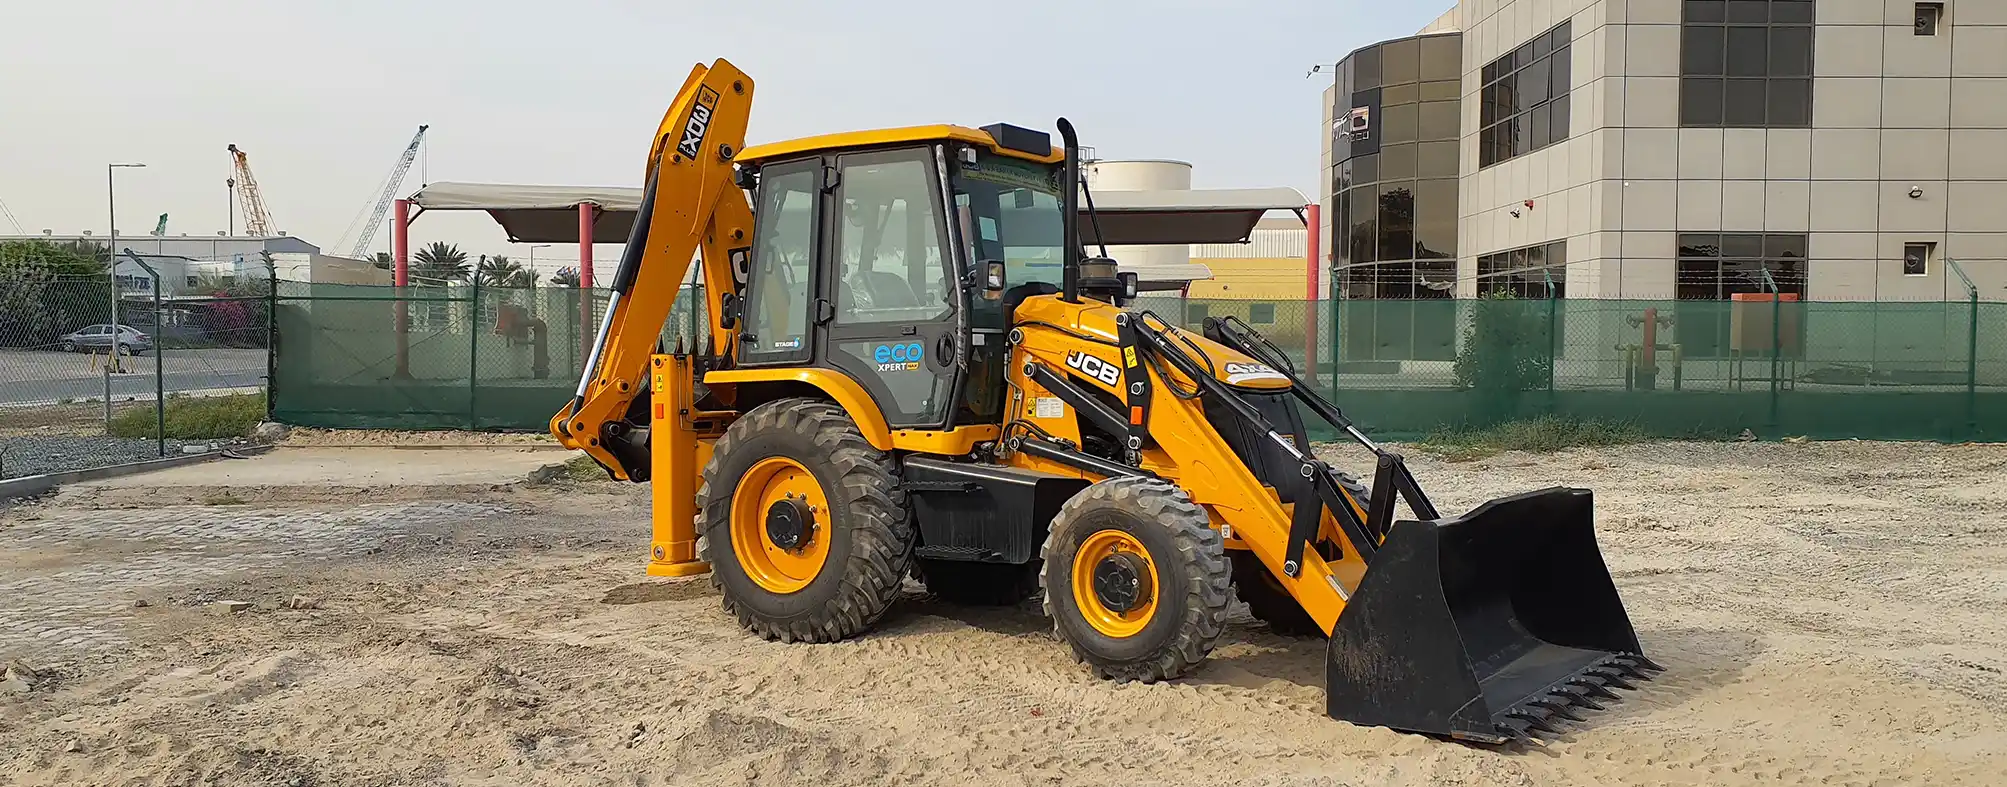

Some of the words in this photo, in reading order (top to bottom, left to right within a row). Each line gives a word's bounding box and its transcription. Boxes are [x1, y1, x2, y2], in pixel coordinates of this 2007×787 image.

[681, 104, 710, 152] 3DX
[874, 343, 923, 364] eco
[877, 362, 907, 372] XPERT
[1067, 351, 1120, 385] JCB
